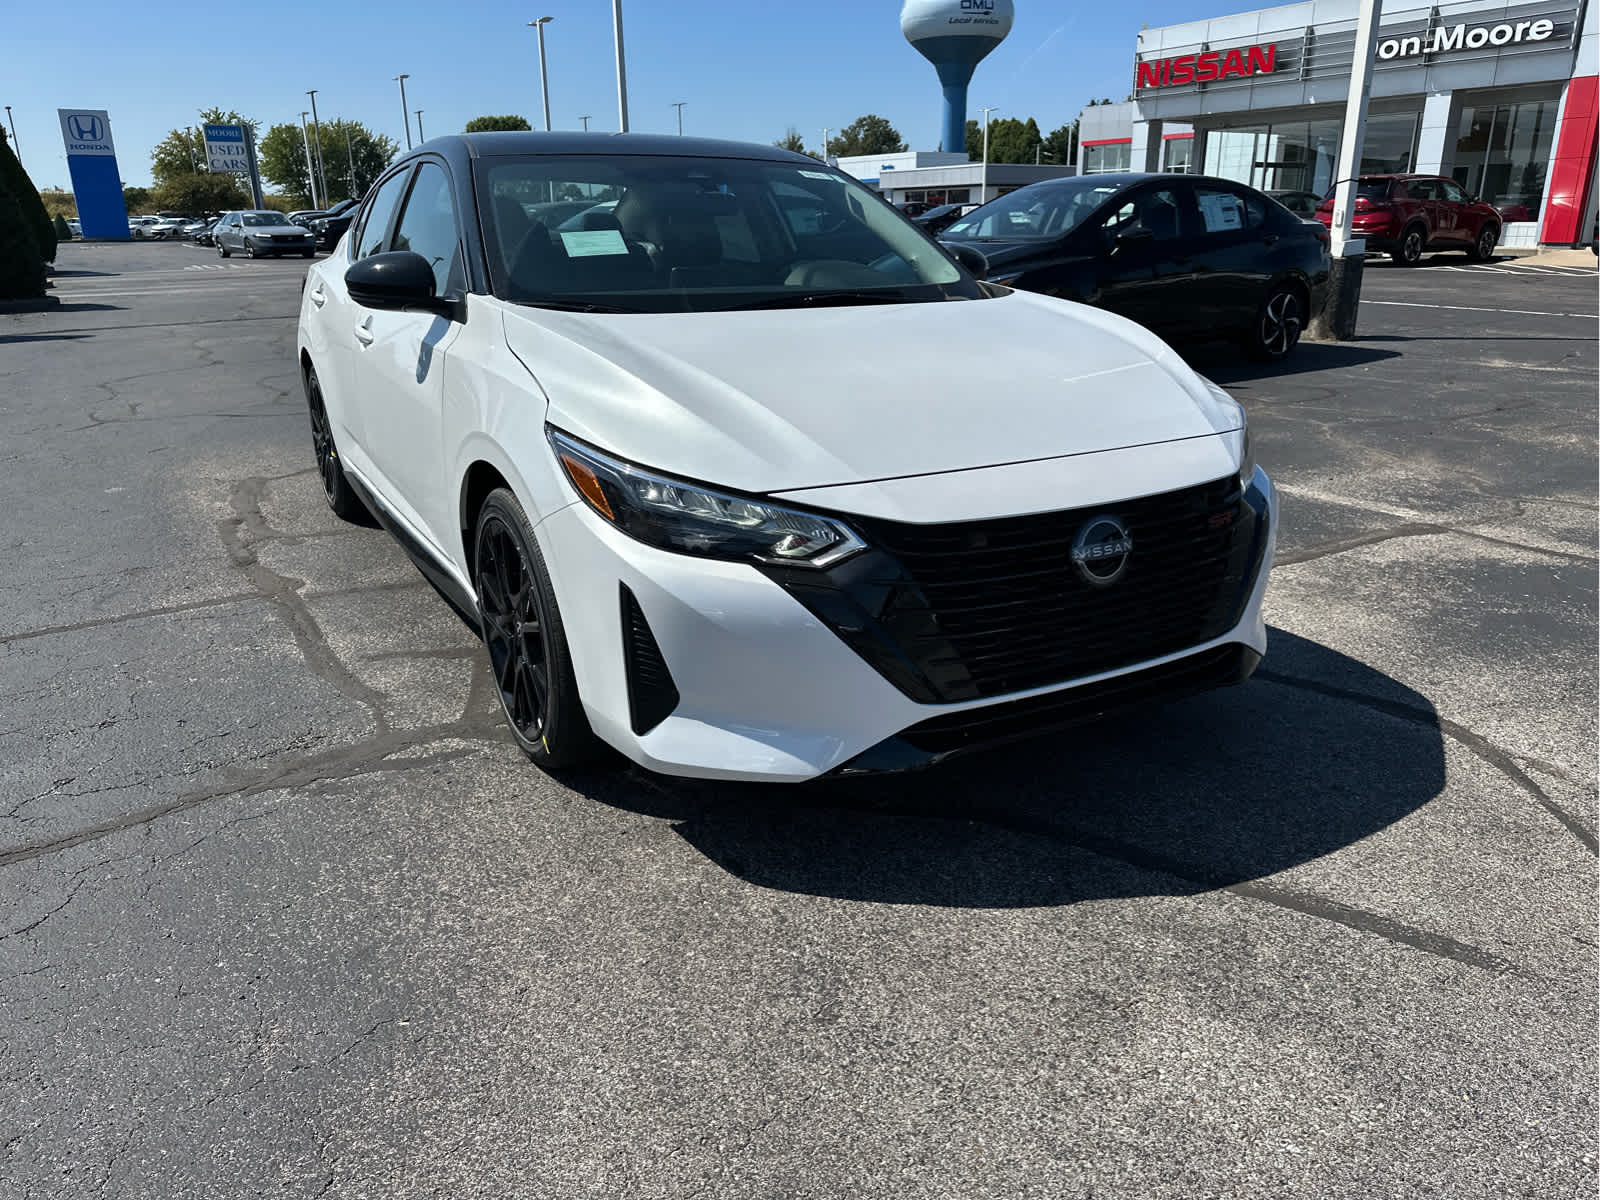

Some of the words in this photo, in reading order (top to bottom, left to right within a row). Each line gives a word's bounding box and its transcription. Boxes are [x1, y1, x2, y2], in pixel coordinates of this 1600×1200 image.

[1376, 36, 1421, 60] on
[1431, 19, 1554, 51] Moore
[1136, 44, 1276, 89] NISSAN
[206, 127, 242, 138] MOORE
[69, 143, 111, 151] HONDA
[209, 145, 246, 156] USED
[211, 159, 248, 170] CARS
[1072, 541, 1132, 561] NISSAN
